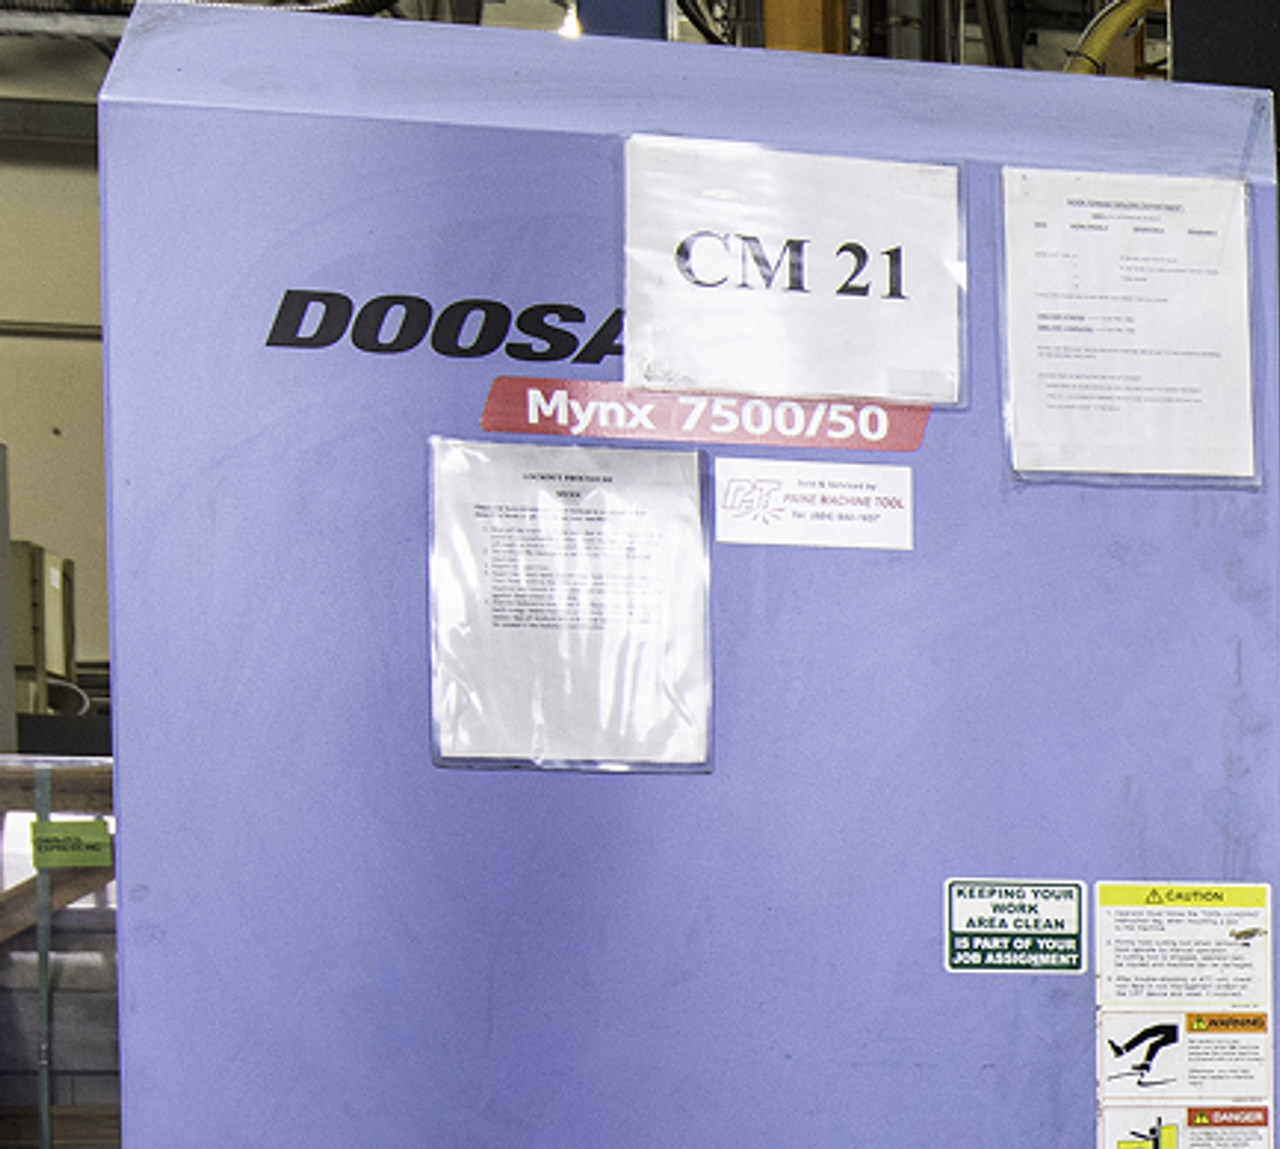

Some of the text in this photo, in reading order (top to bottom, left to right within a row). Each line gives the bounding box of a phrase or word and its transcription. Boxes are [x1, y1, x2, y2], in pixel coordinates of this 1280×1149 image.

[674, 229, 909, 300] CM 21
[265, 288, 624, 365] DOOSA
[526, 388, 889, 441] Mynx 7500/50
[957, 888, 1074, 900] KEEPING YOUR
[1165, 890, 1224, 902] CAUTION
[991, 903, 1039, 914] WORK
[966, 918, 1065, 930] AREA CLEAN
[954, 937, 1077, 950] IS PART OF YOUR
[952, 951, 1079, 965] JOB ASSIGNMENT
[1211, 1111, 1264, 1124] DANGER
